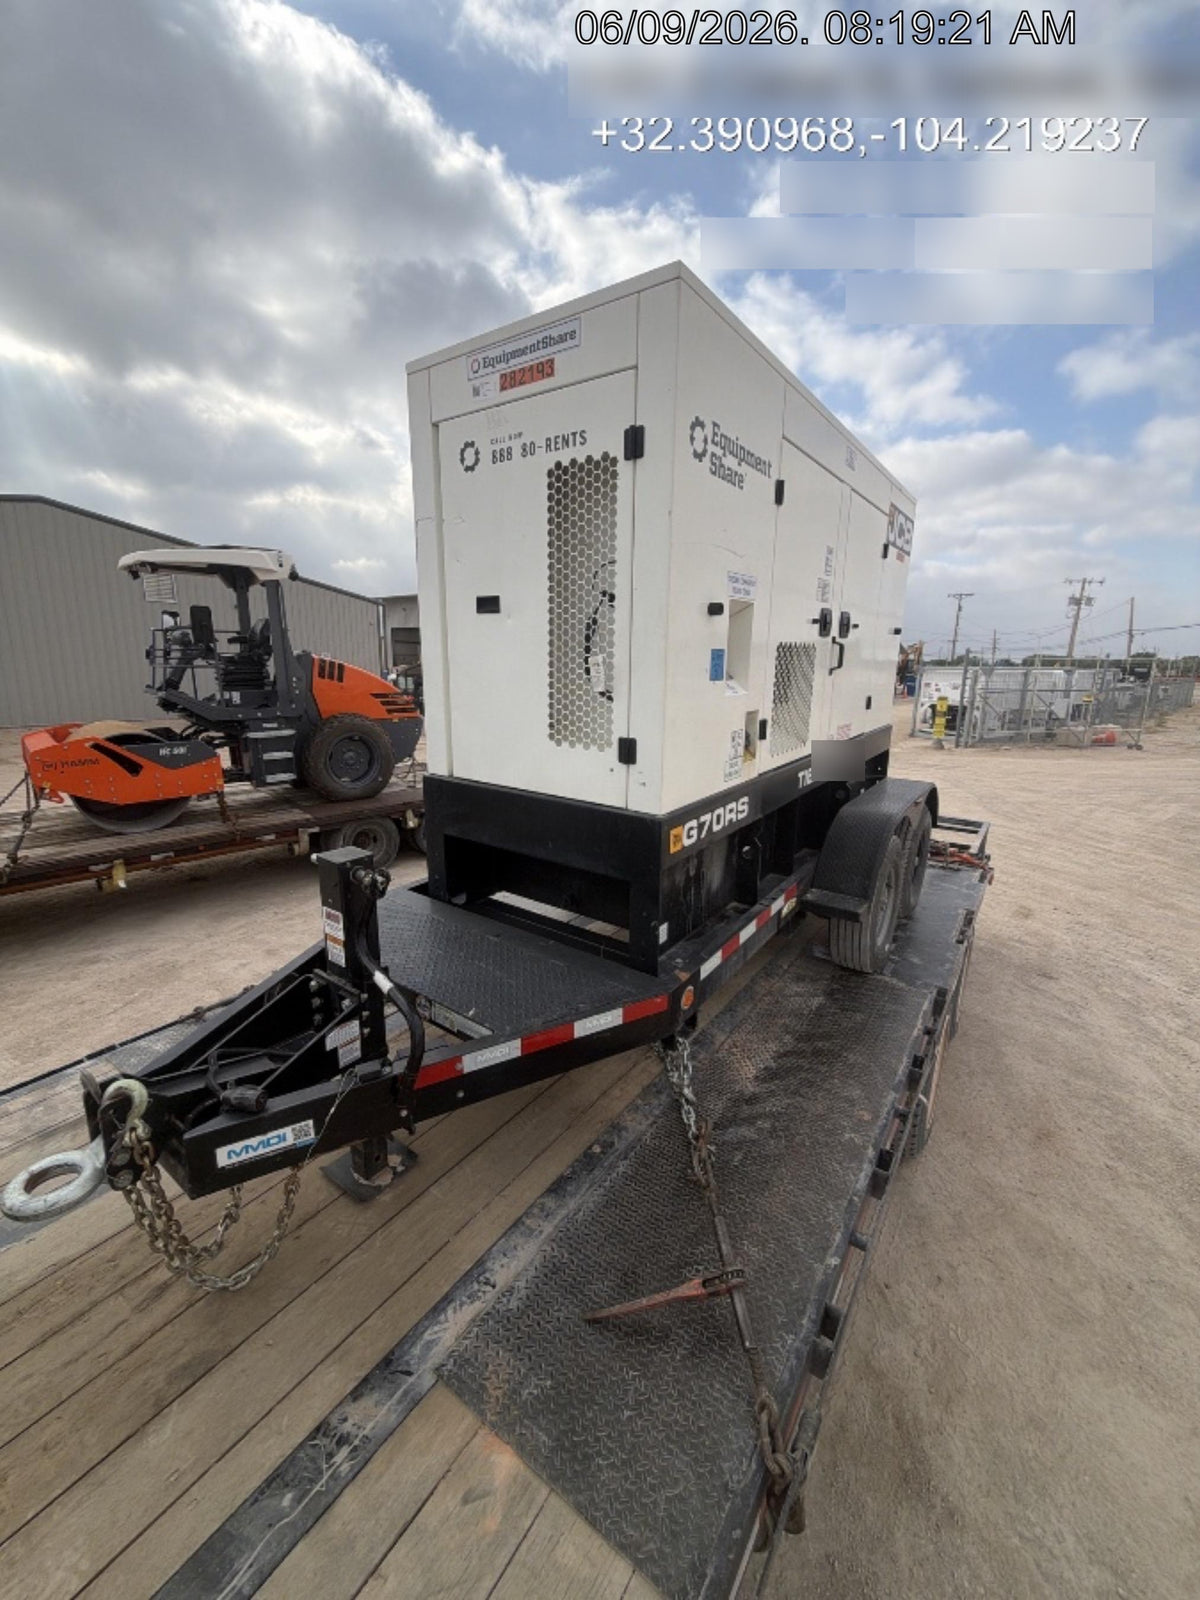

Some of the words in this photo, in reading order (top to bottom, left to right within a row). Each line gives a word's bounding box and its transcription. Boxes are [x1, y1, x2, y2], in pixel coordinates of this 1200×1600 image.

[482, 329, 577, 369] EquipmentShare
[499, 358, 556, 391] 282193
[491, 446, 513, 465] 888
[520, 429, 588, 458] 80-RENTS
[710, 420, 773, 480] Equipment
[709, 451, 744, 491] Share
[682, 796, 750, 847] G70RS
[227, 1131, 287, 1160] MMDI
